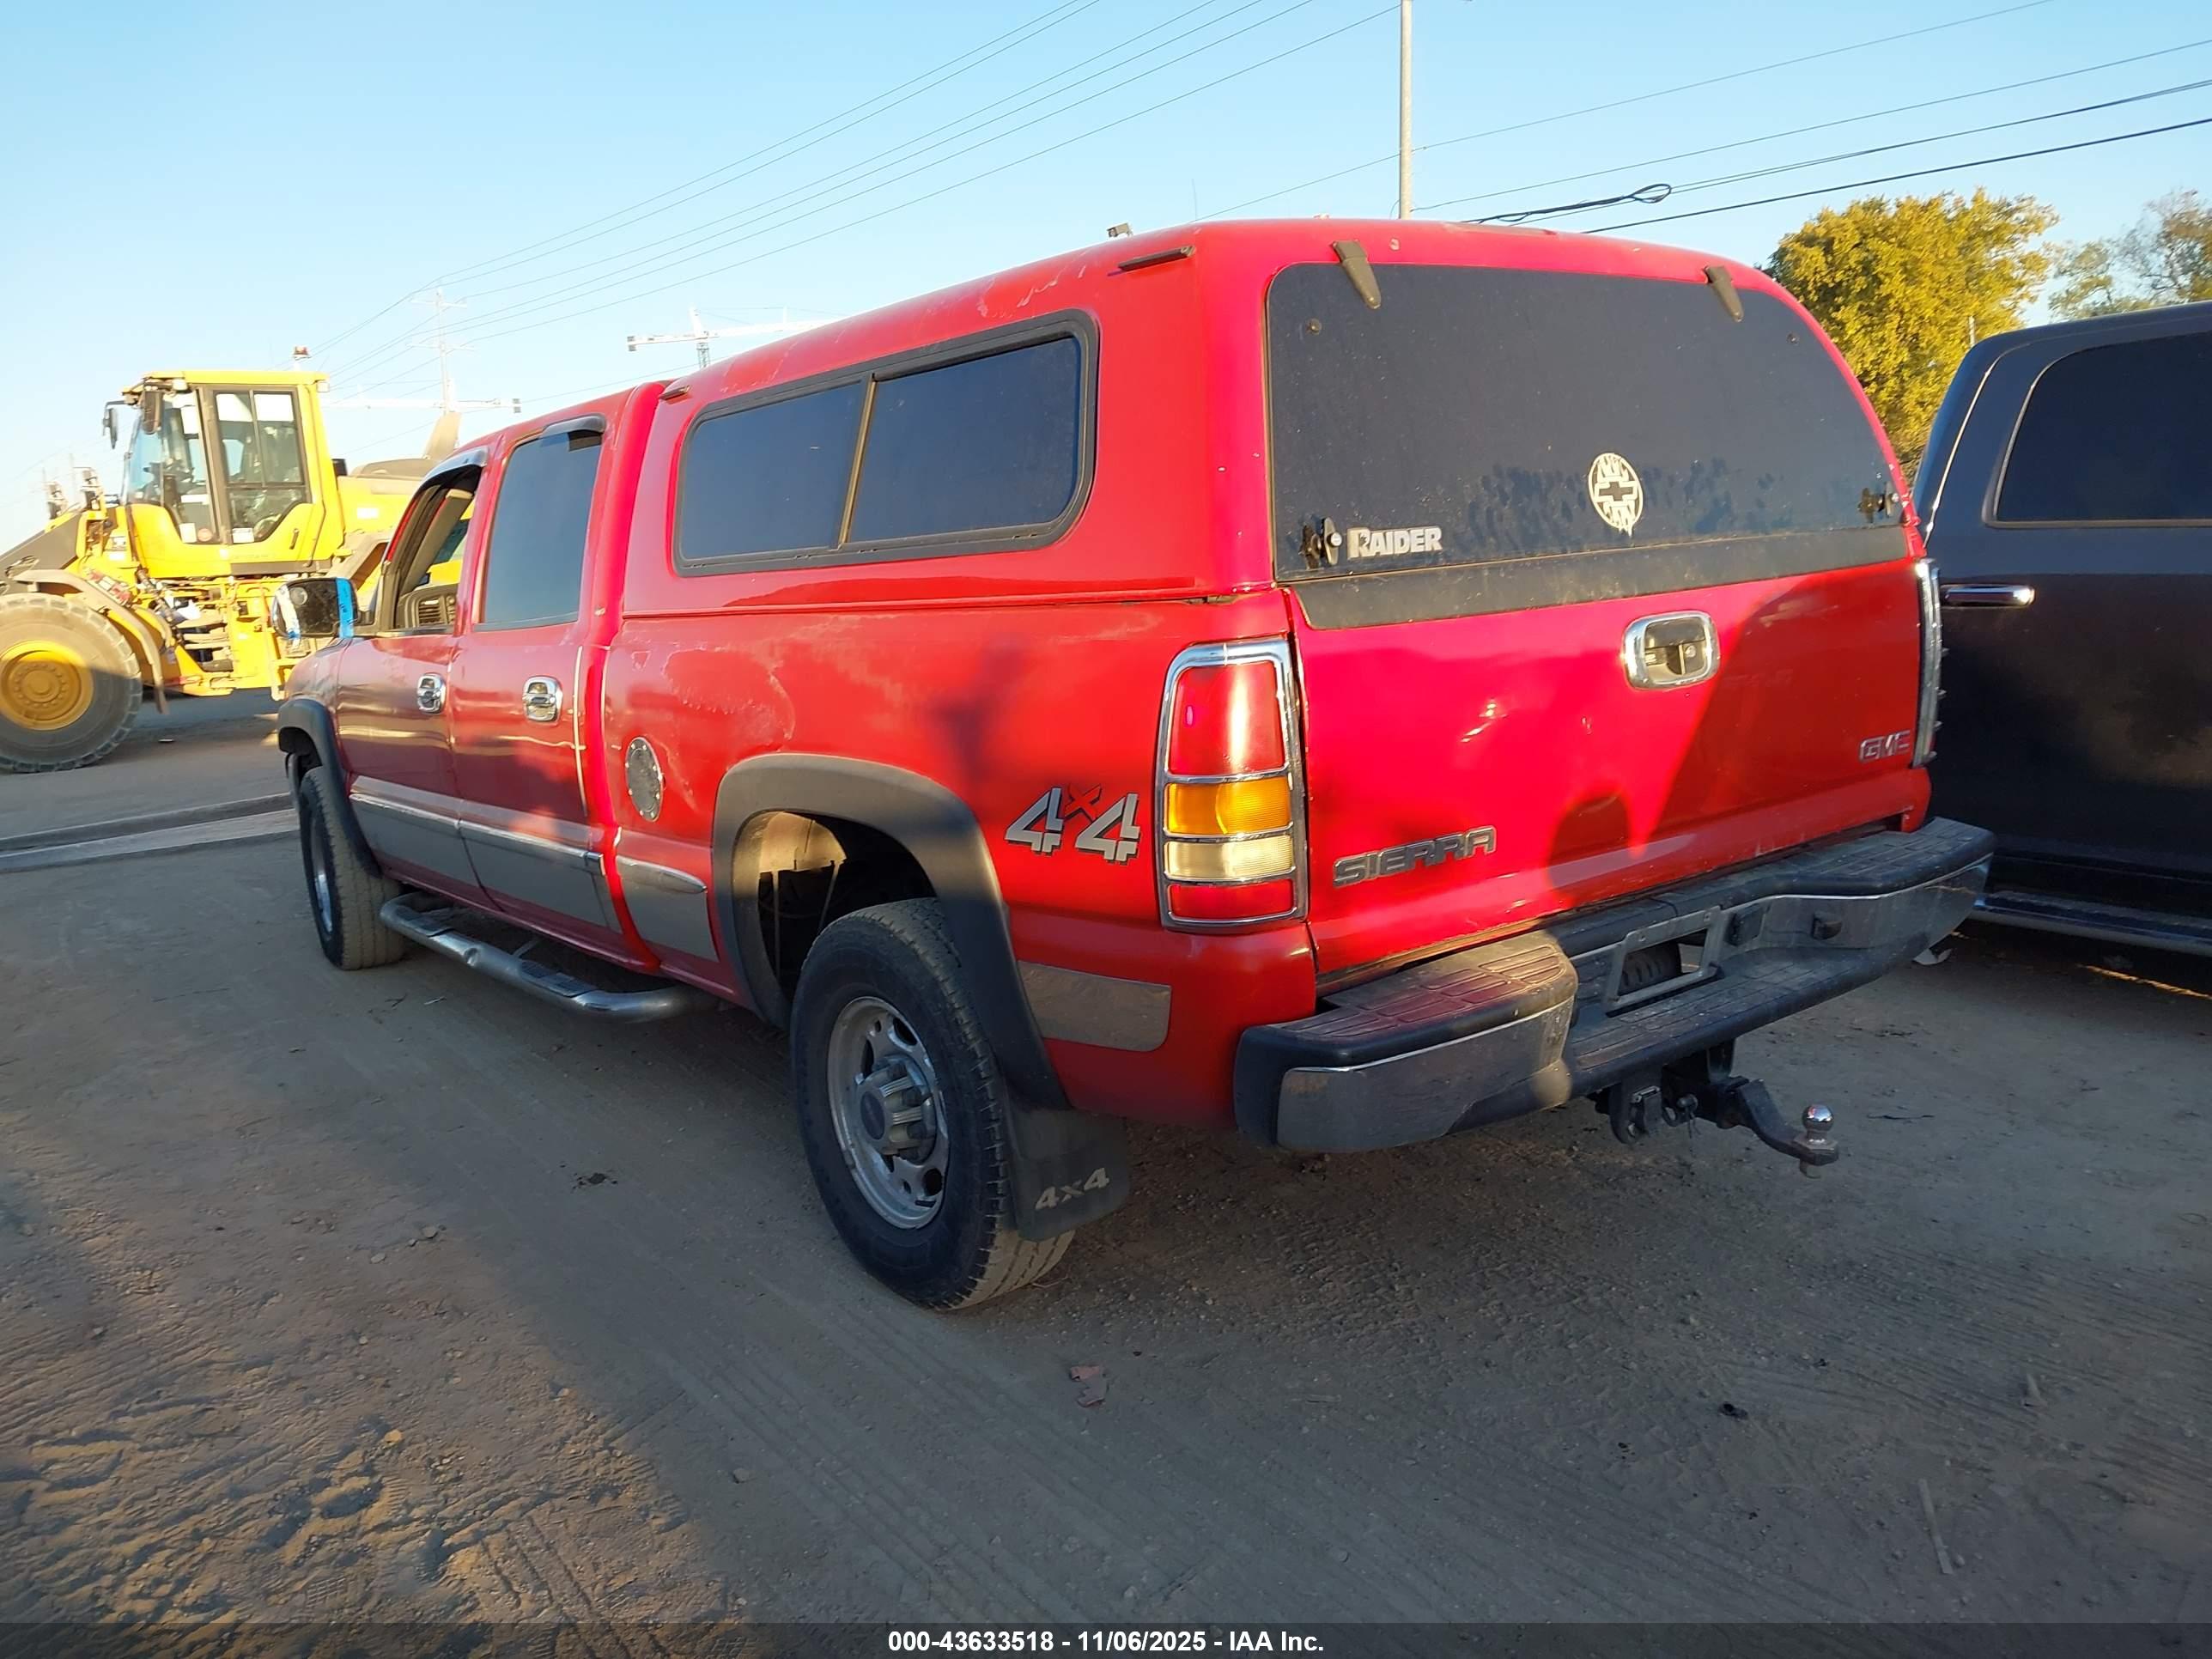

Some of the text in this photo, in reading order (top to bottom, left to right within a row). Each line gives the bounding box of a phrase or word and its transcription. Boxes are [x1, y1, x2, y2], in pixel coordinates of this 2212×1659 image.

[1346, 526, 1443, 560] RAIDER
[1858, 729, 1911, 763] GMC
[1333, 825, 1497, 888] SIERRA
